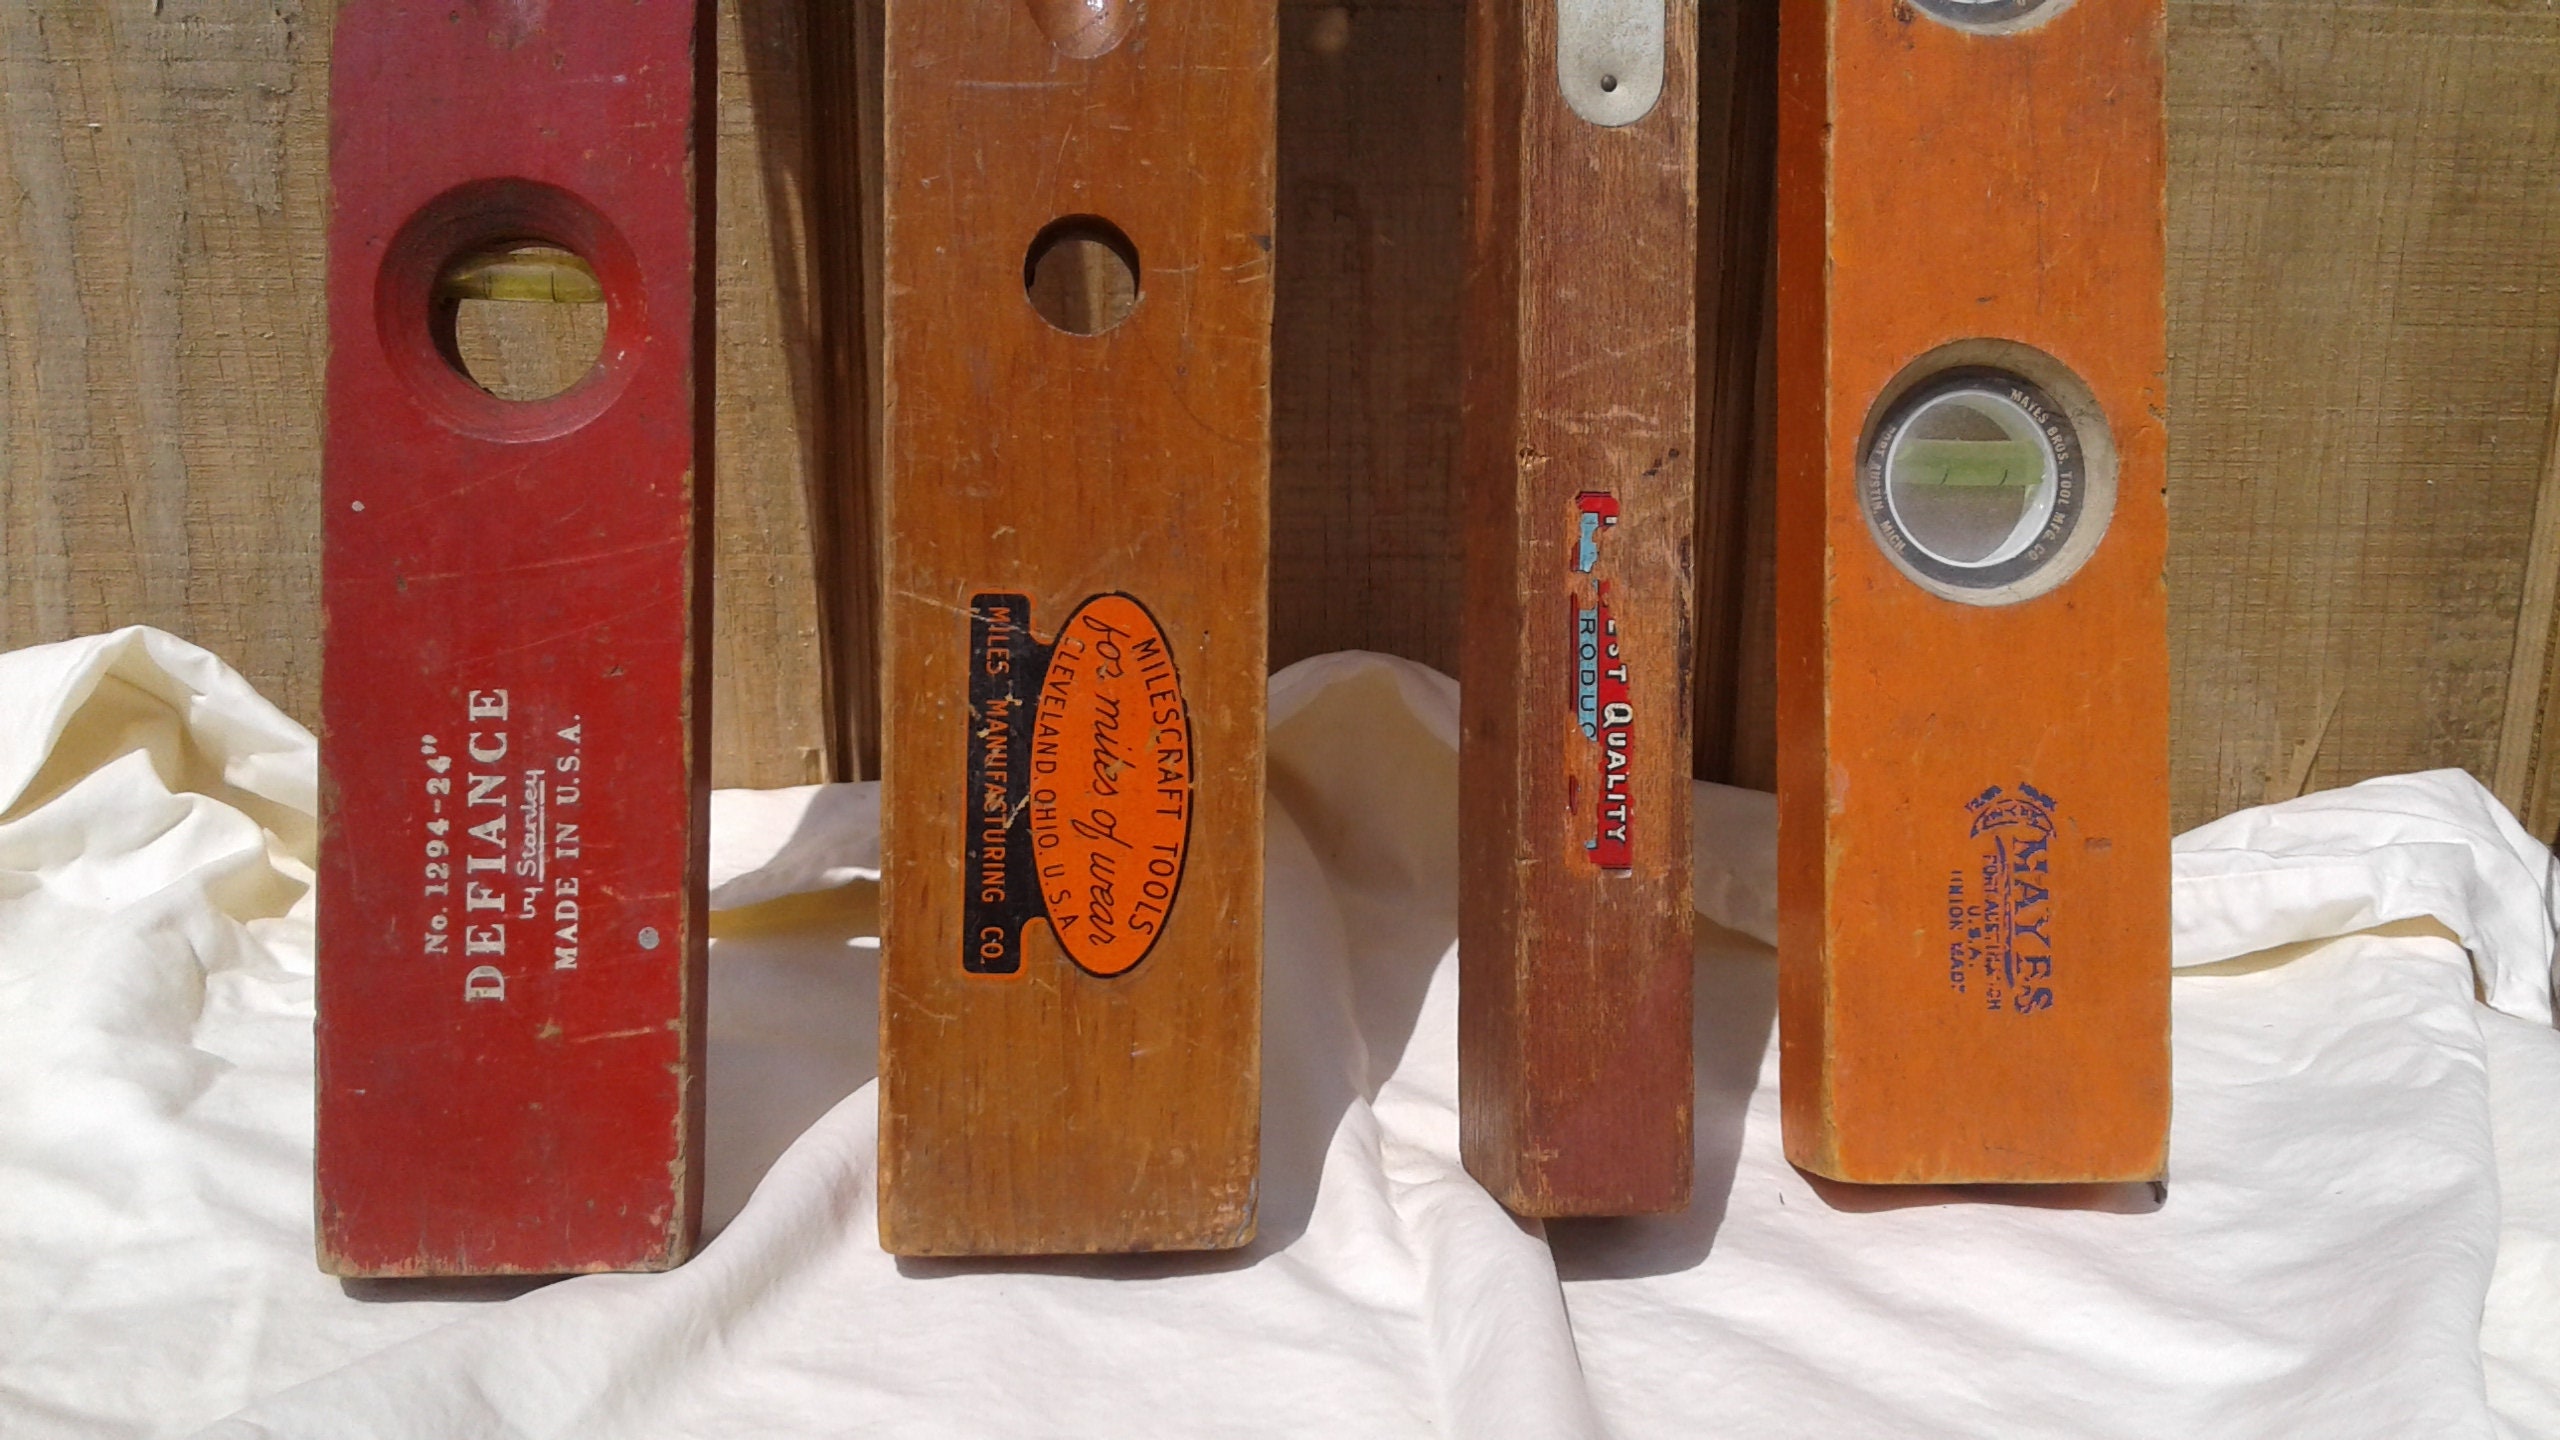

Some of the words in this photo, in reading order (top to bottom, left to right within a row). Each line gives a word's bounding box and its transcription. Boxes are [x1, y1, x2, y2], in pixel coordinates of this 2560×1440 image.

[2010, 388, 2049, 425] MAYES
[2046, 426, 2069, 465] BROS.
[2057, 471, 2073, 506] TOOL
[985, 606, 1010, 675] MILES
[1082, 615, 1130, 681] for
[1579, 618, 1598, 739] RODUC
[556, 714, 581, 804] U.S.A.
[1092, 694, 1136, 796] miles
[1131, 637, 1182, 820] MILESCRAFT
[1603, 702, 1634, 845] QUALITY
[465, 688, 508, 1002] DEFIANCE
[515, 769, 545, 879] Stanley
[556, 823, 579, 859] IN
[981, 699, 1009, 903] MANUFACTURING
[1070, 809, 1133, 849] of
[425, 907, 449, 954] No.
[518, 887, 544, 919] by
[554, 877, 579, 969] MADE
[1088, 852, 1117, 946] wear
[1128, 844, 1179, 935] TOOLS
[2013, 837, 2054, 1014] MAYES
[979, 926, 1004, 964] CO.
[1967, 905, 1981, 967] U.S.A.
